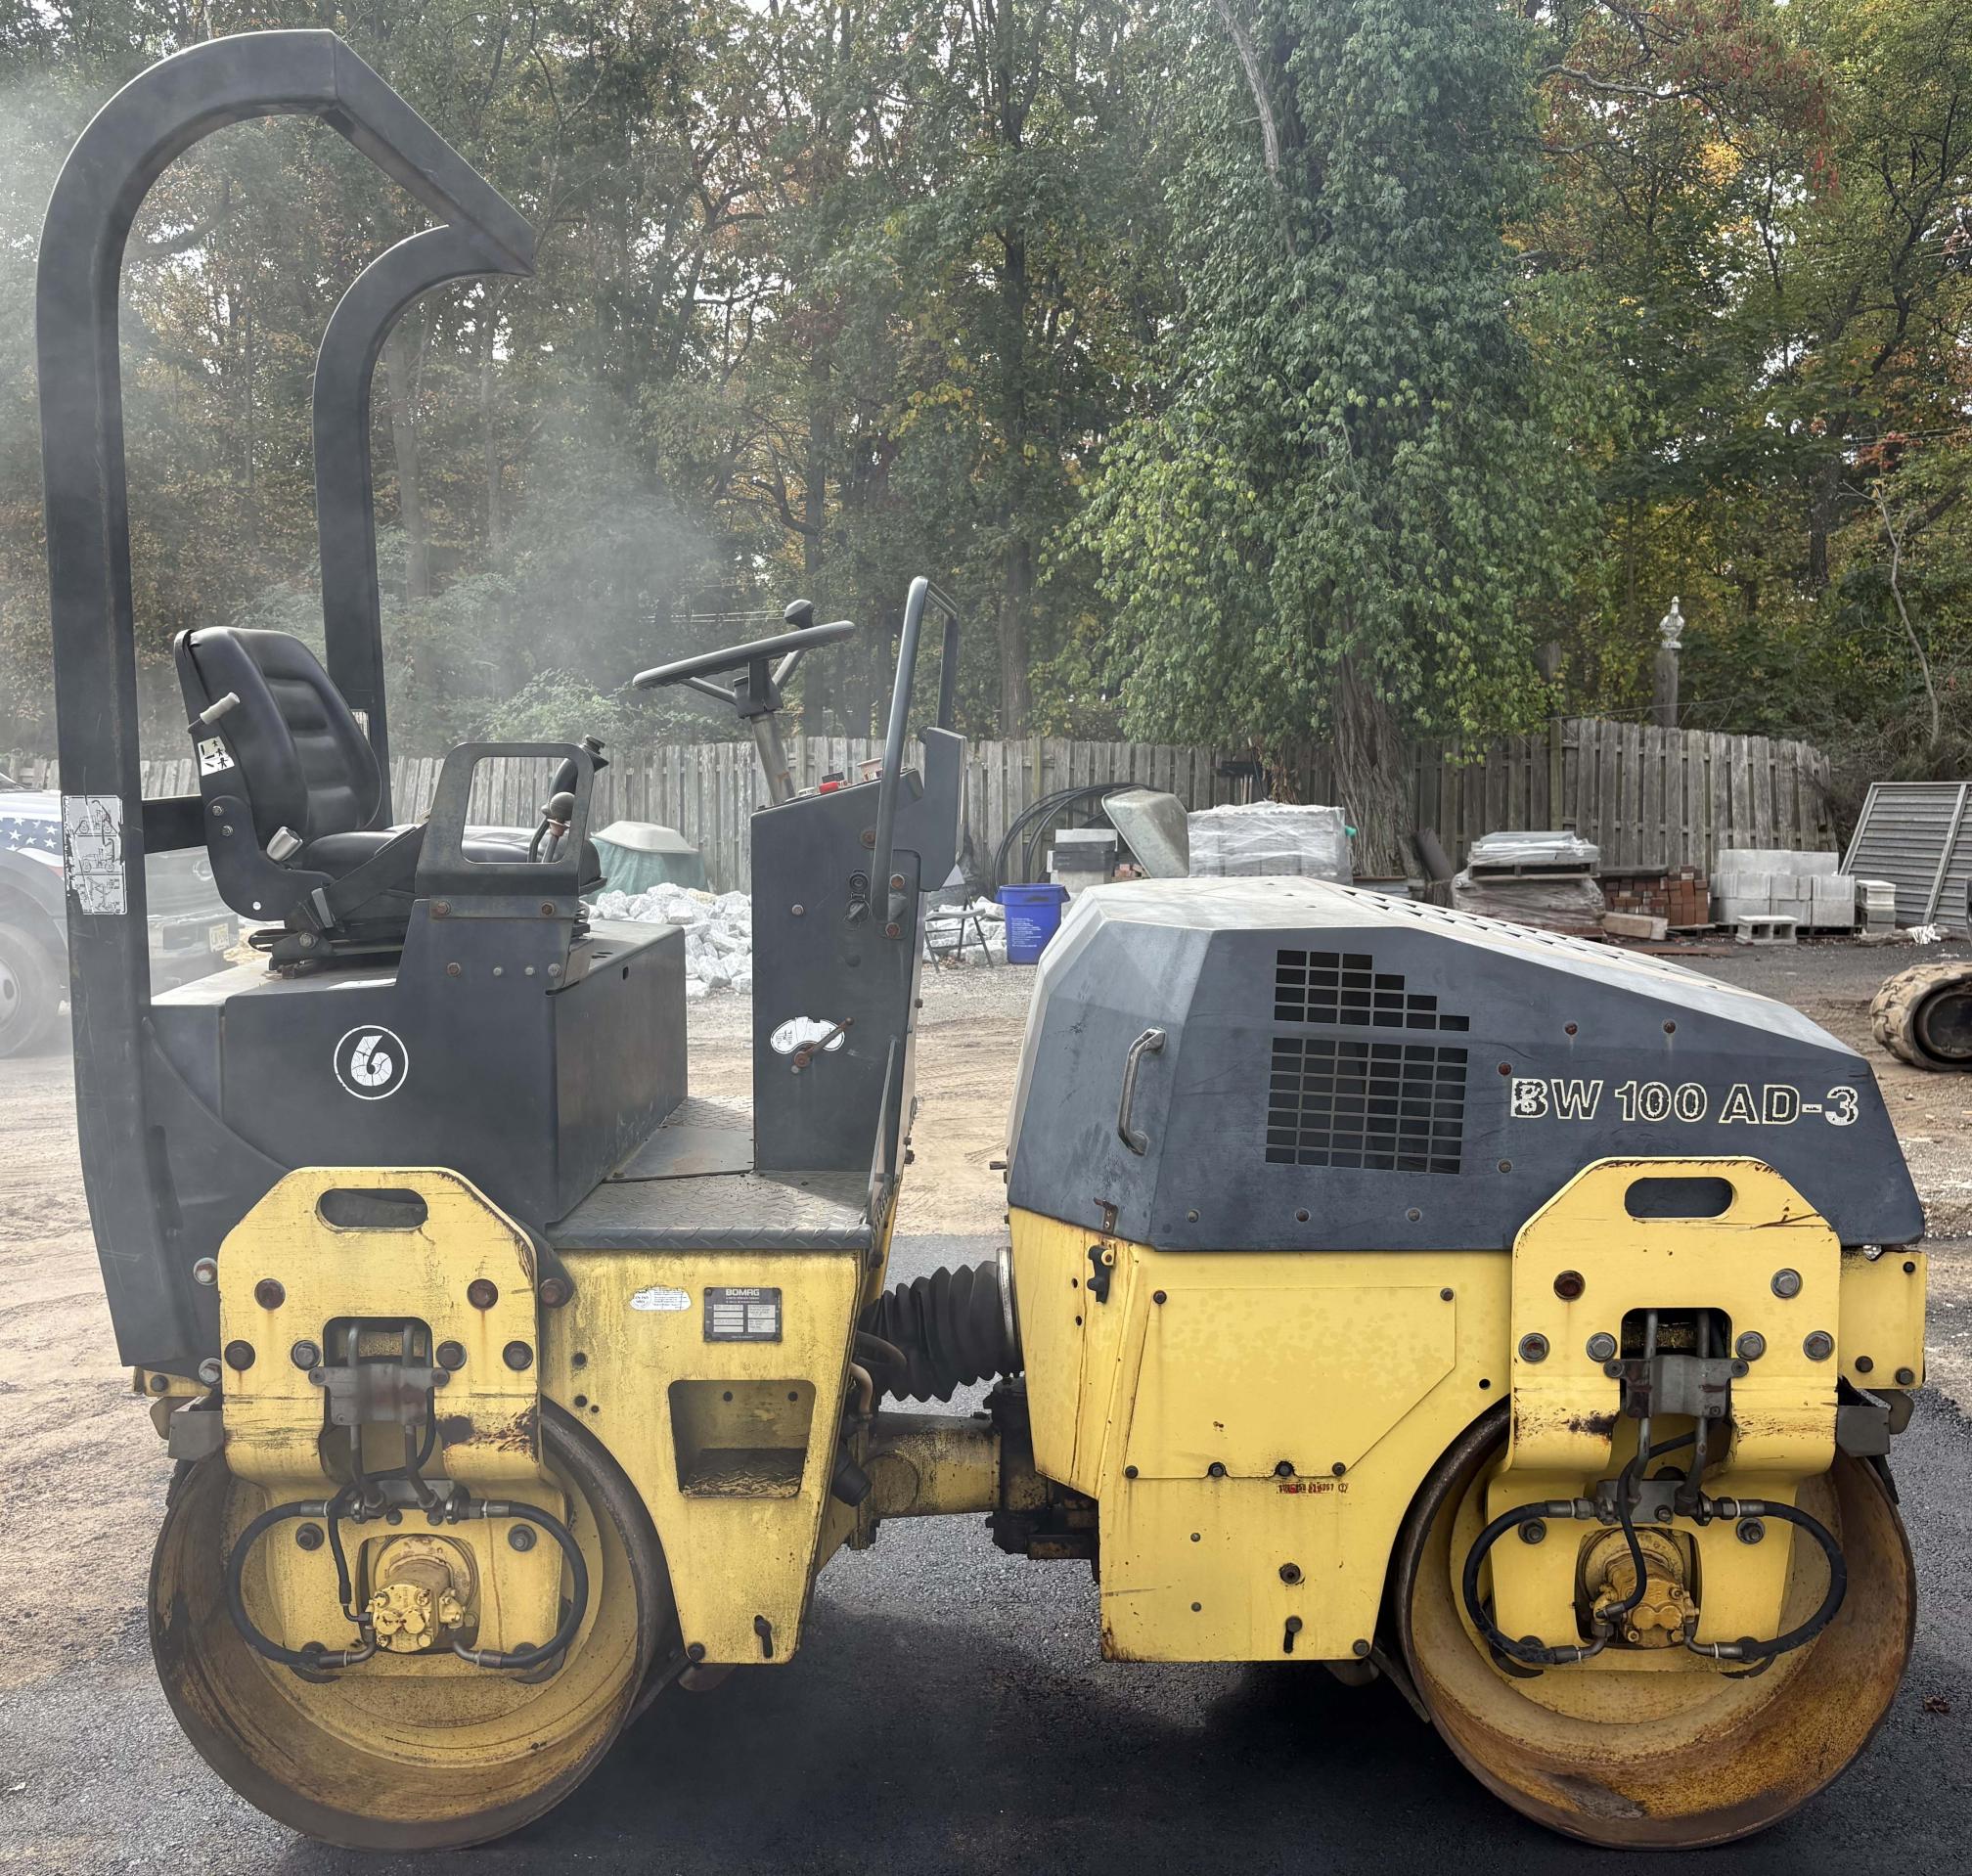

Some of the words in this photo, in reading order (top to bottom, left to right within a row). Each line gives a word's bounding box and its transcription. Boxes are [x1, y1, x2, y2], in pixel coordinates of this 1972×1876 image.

[350, 1035, 393, 1087] 6
[1510, 1077, 1604, 1120] BW
[1615, 1080, 1708, 1122] 100
[1719, 1083, 1860, 1127] AD-3
[725, 1288, 760, 1297] BOMAG
